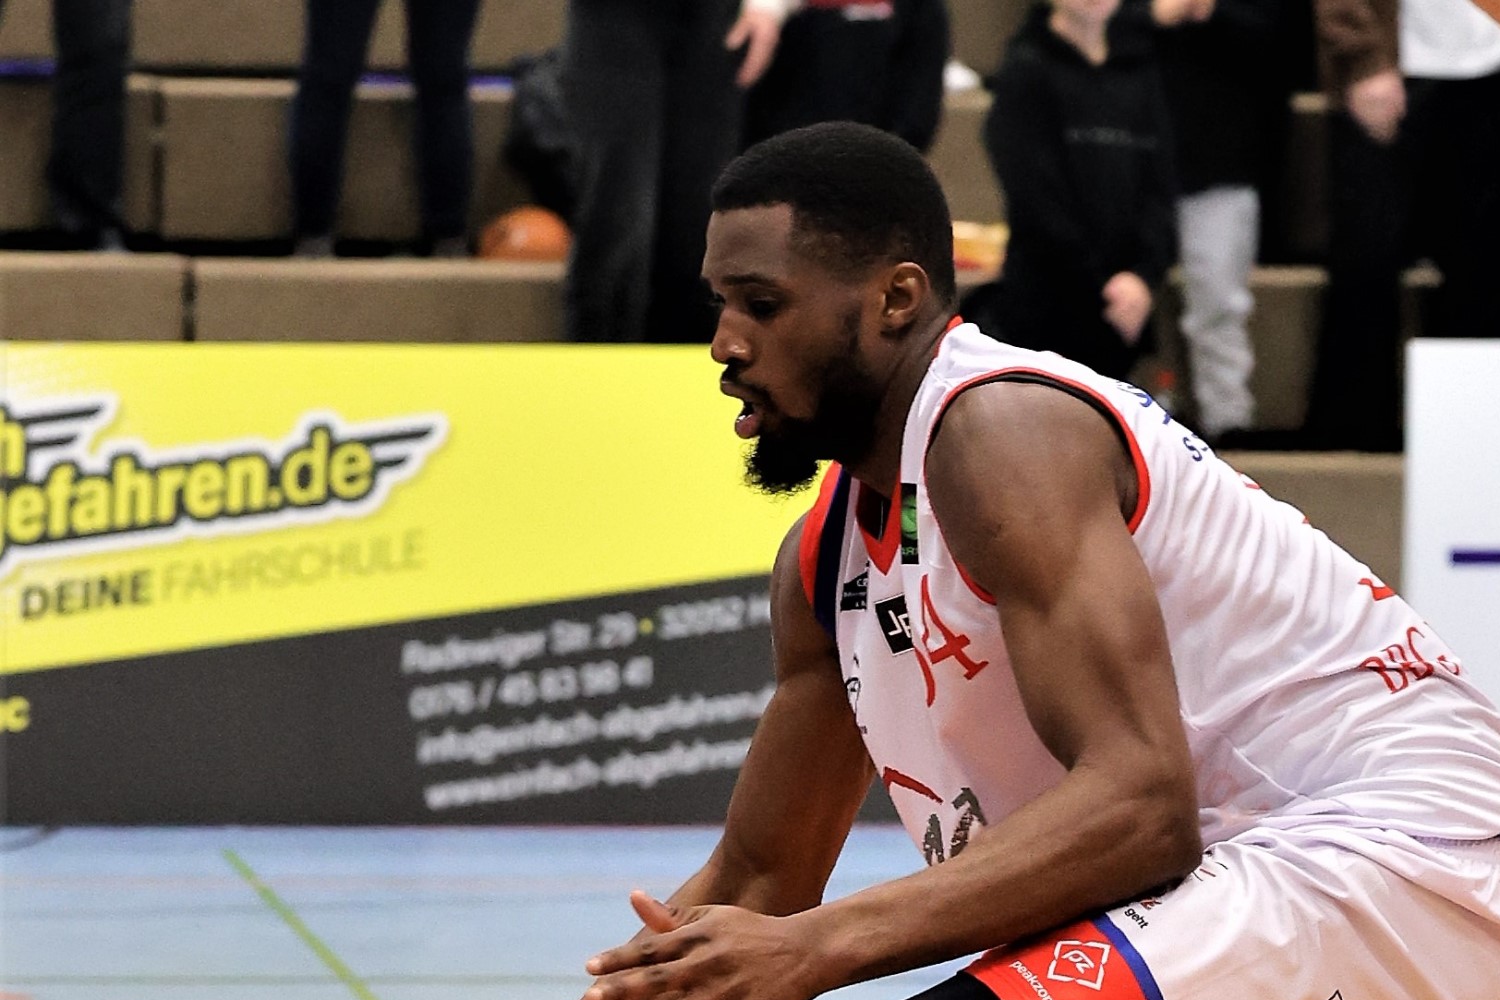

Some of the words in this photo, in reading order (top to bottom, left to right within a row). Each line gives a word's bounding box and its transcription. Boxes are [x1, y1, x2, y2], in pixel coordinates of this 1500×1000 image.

[0, 424, 375, 560] efahren.de
[20, 572, 152, 621] DEINE
[160, 531, 426, 600] FAHRSCHULE
